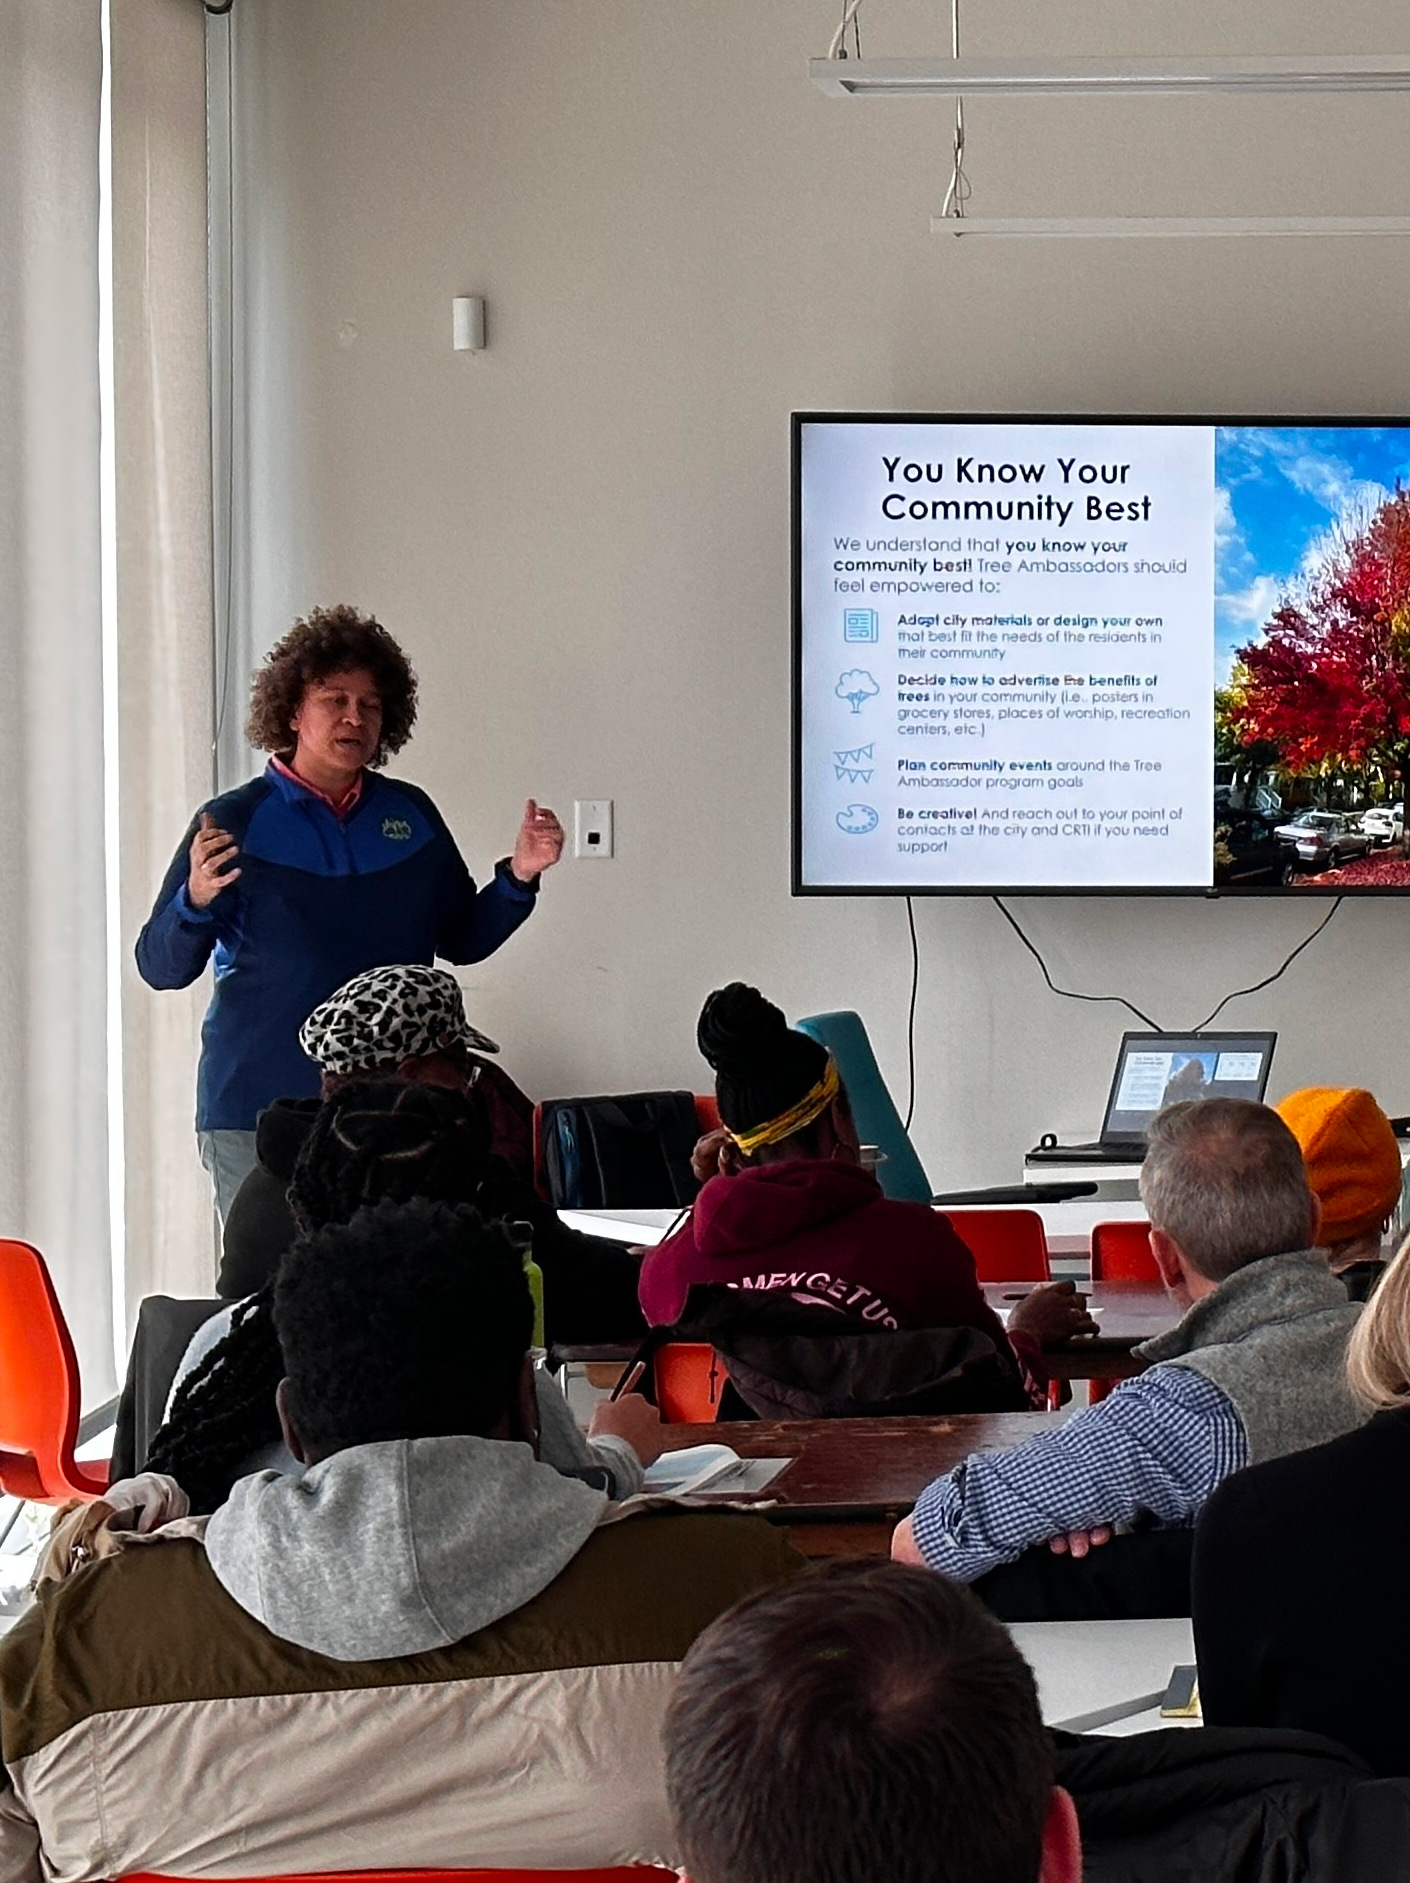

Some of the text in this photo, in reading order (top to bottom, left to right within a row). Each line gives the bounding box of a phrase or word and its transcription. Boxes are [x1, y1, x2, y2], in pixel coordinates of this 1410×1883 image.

[882, 457, 1130, 484] You Know Your
[882, 494, 1152, 528] Community Best
[833, 537, 1128, 557] We understand that you know your
[833, 557, 1187, 577] community best! Tree Ambassadors should
[833, 577, 1001, 597] feel empowered to:
[897, 613, 1163, 630] Adapt city materials or design your own
[898, 629, 1162, 643] that best fit the needs of the residents in
[898, 645, 1006, 661] their community
[897, 673, 1158, 687] Decide how to advertise the benefits of
[897, 688, 930, 703] trees
[933, 688, 945, 703] in
[948, 692, 978, 706] your
[981, 688, 1057, 706] community
[1092, 688, 1138, 706] posters
[1142, 688, 1153, 703] in
[898, 706, 1190, 723] grocery stores, places of worship, recreation
[897, 722, 985, 738] centers, etc.)
[898, 758, 1162, 775] Plan community events around the Tree
[898, 774, 1083, 791] Ambassador program goals
[897, 806, 1183, 823] Be creative! And reach out to your point of
[897, 823, 957, 837] contacts
[960, 823, 974, 837] at
[979, 823, 1000, 837] the
[1003, 823, 1028, 839] city
[1031, 823, 1058, 837] and
[1094, 823, 1101, 837] if
[1105, 826, 1130, 839] you
[1133, 823, 1169, 837] need
[897, 839, 947, 855] support
[806, 1272, 872, 1305] GET
